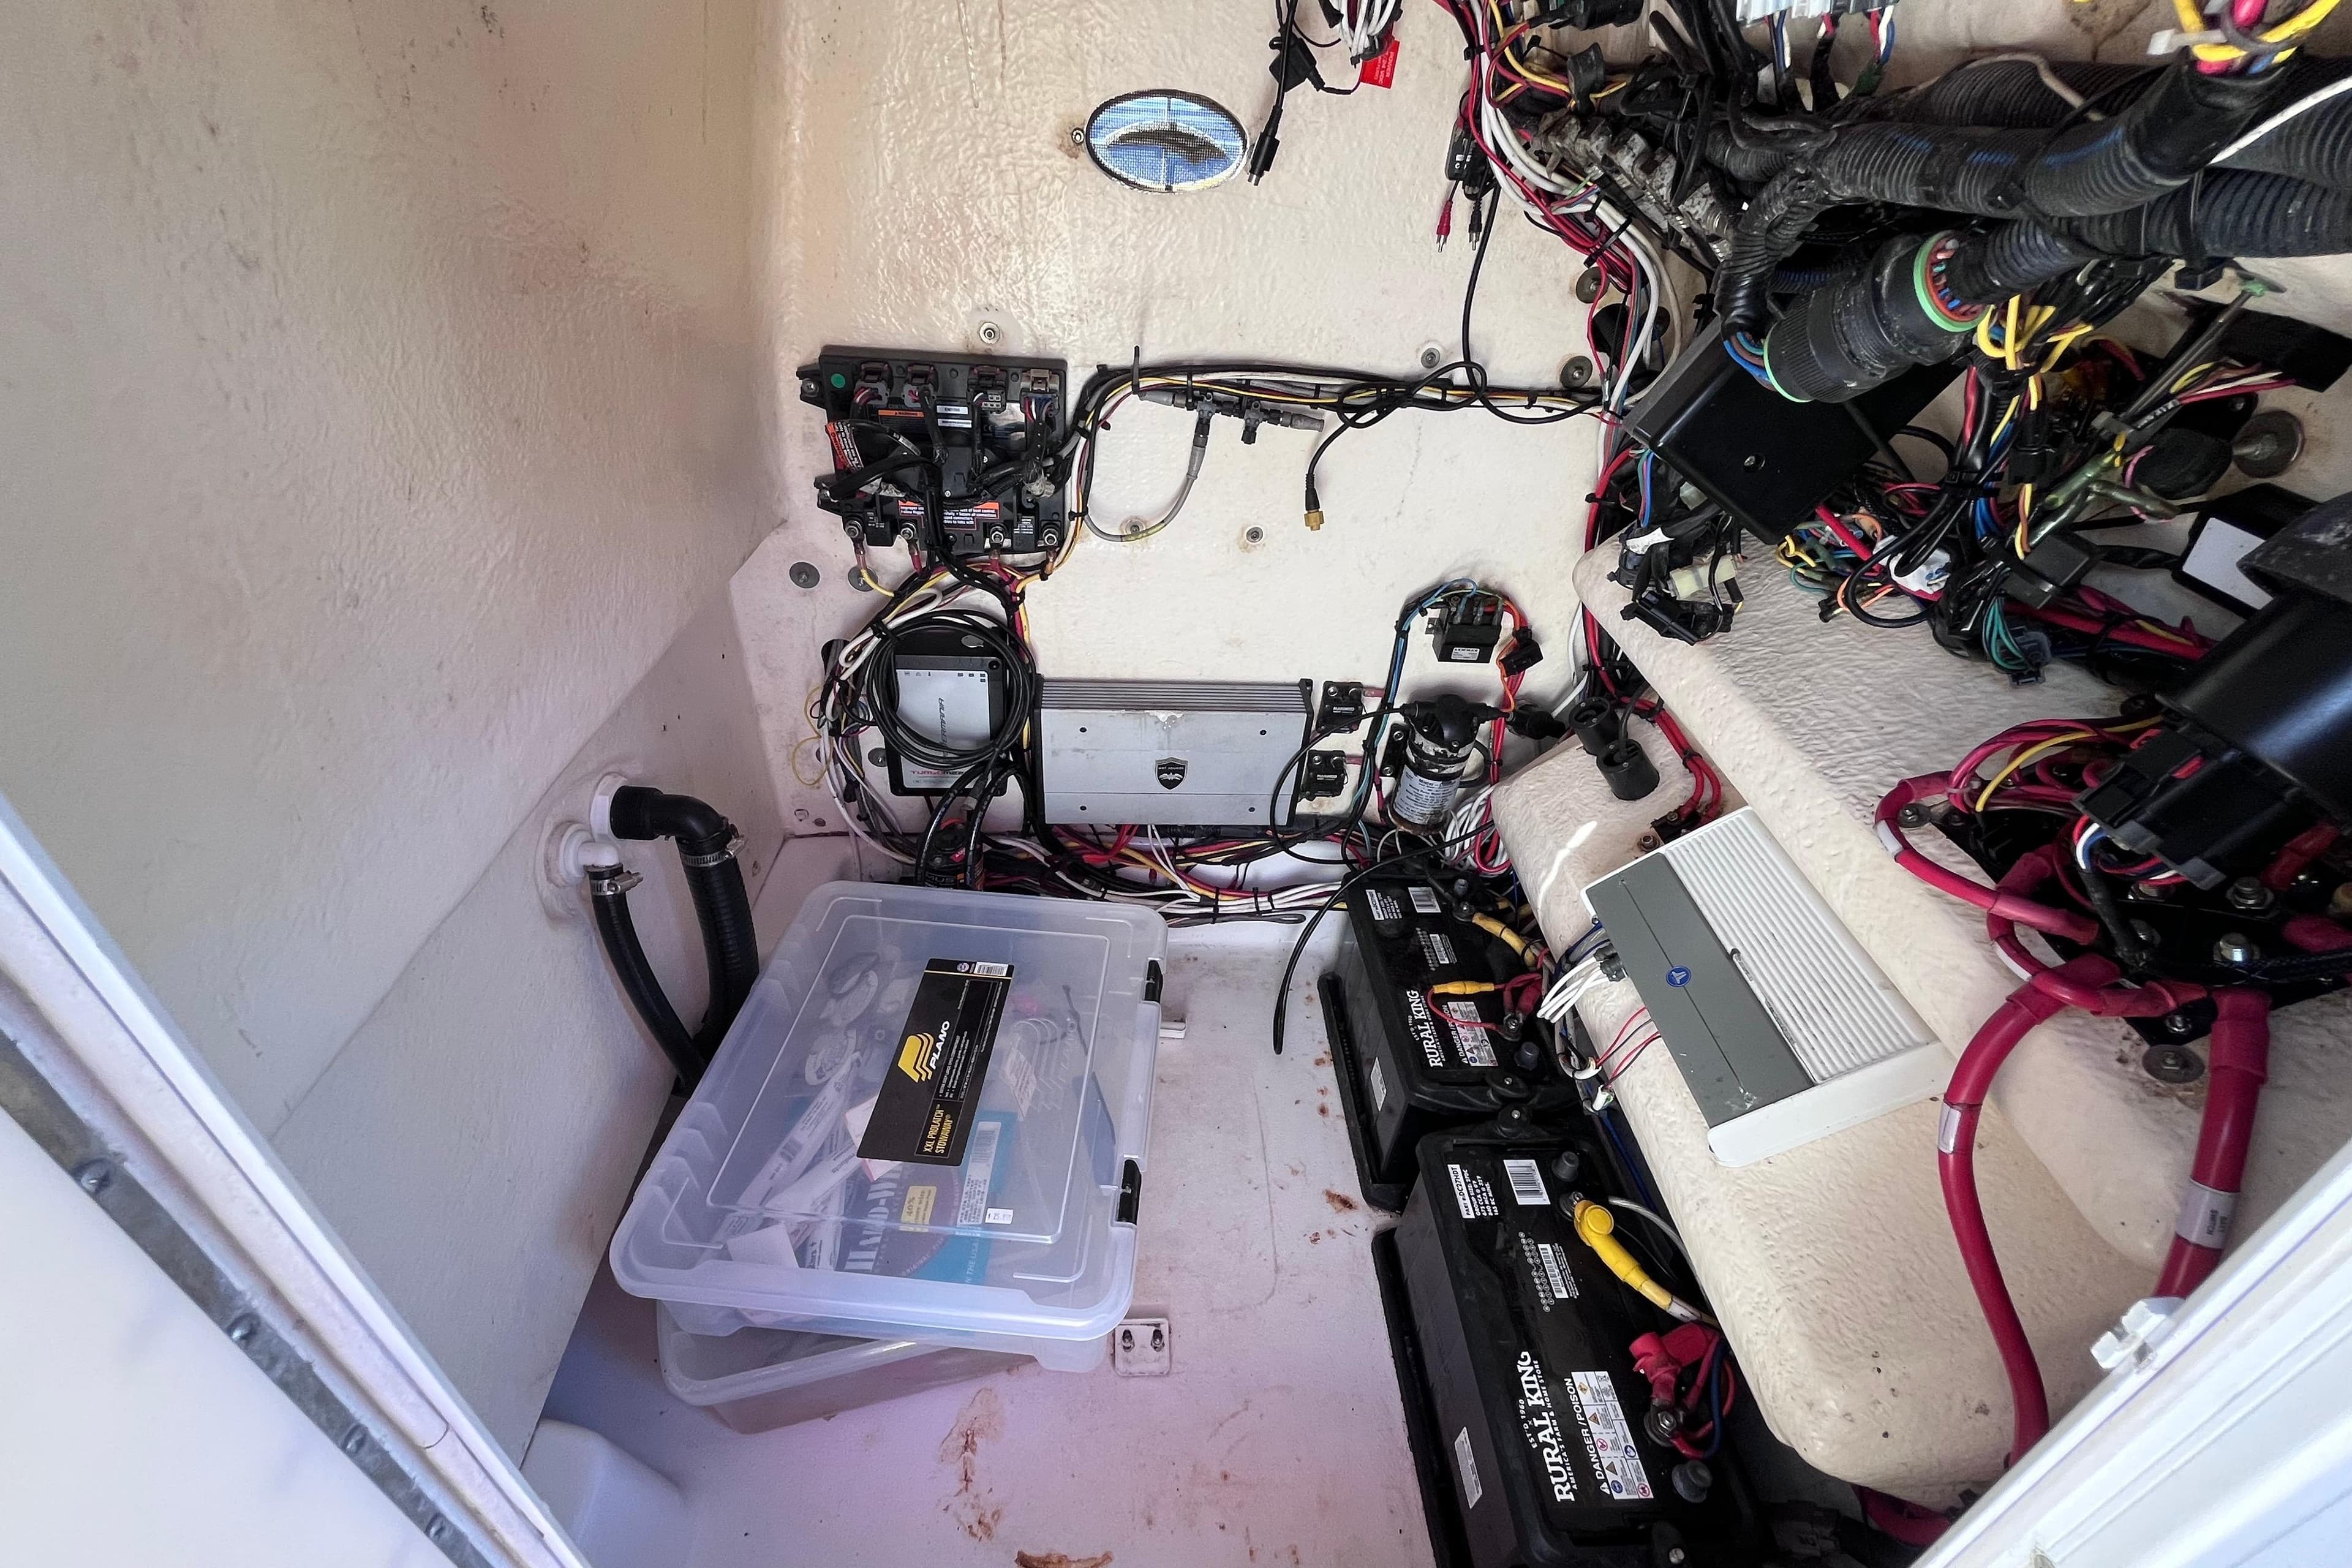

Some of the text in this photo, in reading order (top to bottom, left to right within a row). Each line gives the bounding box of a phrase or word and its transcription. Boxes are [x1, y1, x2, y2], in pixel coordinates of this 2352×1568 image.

[1406, 989, 1443, 1067] RURAL KING
[929, 1020, 951, 1069] PLANO
[1451, 1030, 1465, 1057] DANGER
[922, 1140, 936, 1153] XXL
[1471, 1196, 1480, 1216] GROUP
[969, 1243, 979, 1259] USA
[967, 1259, 976, 1275] THE
[1532, 1360, 1545, 1384] STORE
[1541, 1385, 1552, 1408] HOME
[1518, 1398, 1527, 1420] 1960
[1516, 1351, 1575, 1502] RURAL KING
[1551, 1420, 1563, 1441] FARM
[1581, 1428, 1605, 1480] DANGER
[1559, 1444, 1578, 1490] AMERICA'S
